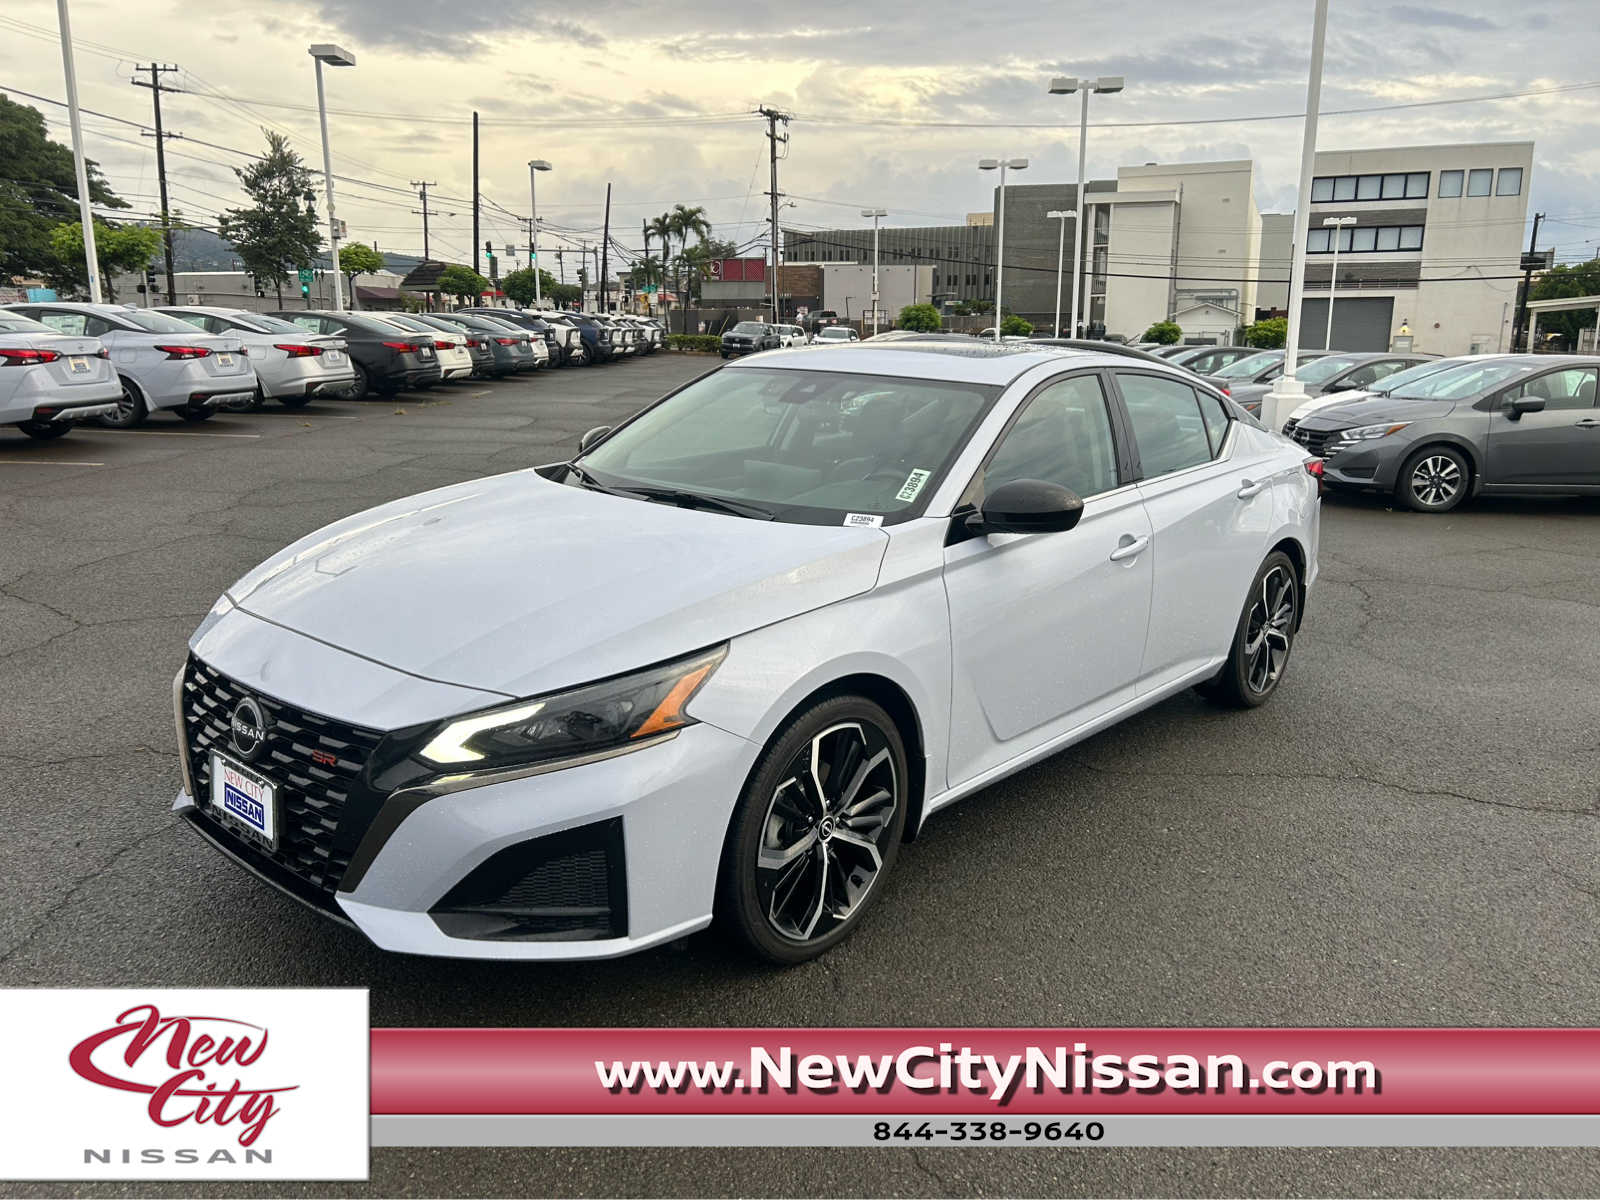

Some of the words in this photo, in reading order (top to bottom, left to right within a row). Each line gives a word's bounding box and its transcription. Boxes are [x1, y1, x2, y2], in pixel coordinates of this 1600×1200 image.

[312, 749, 336, 767] SR
[224, 767, 243, 791] NEW
[245, 780, 265, 803] CITY
[226, 790, 263, 824] NISSAN
